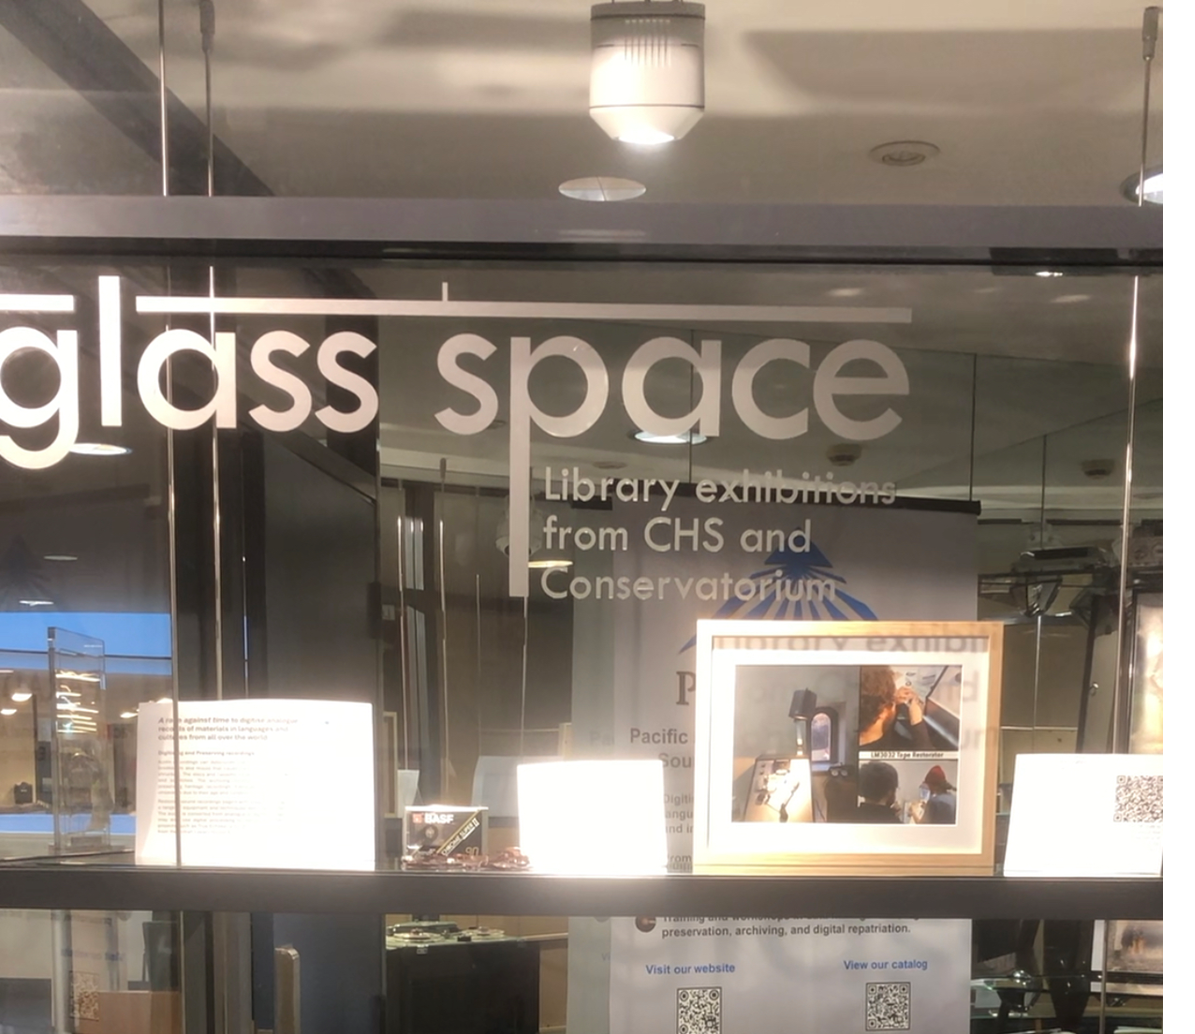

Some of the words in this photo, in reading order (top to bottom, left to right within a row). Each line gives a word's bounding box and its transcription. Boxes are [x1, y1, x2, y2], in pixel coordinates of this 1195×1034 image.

[0, 275, 380, 470] glass
[434, 332, 910, 598] space
[545, 466, 680, 512] Library
[695, 469, 897, 505] exhibitions
[543, 515, 628, 551] from
[644, 517, 725, 553] CHS
[740, 519, 811, 553] and
[541, 566, 836, 601] Conservatorium
[630, 727, 689, 745] Pacific
[424, 813, 454, 824] BASF
[661, 926, 732, 938] preservation,
[735, 925, 788, 937] archiving,
[790, 925, 811, 934] and
[813, 924, 846, 936] digital
[848, 923, 911, 936] repatriation.
[646, 964, 671, 975] Visit
[673, 966, 691, 974] our
[694, 963, 735, 974] website
[843, 960, 869, 970] View
[871, 962, 889, 970] our
[892, 959, 928, 972] catalog
